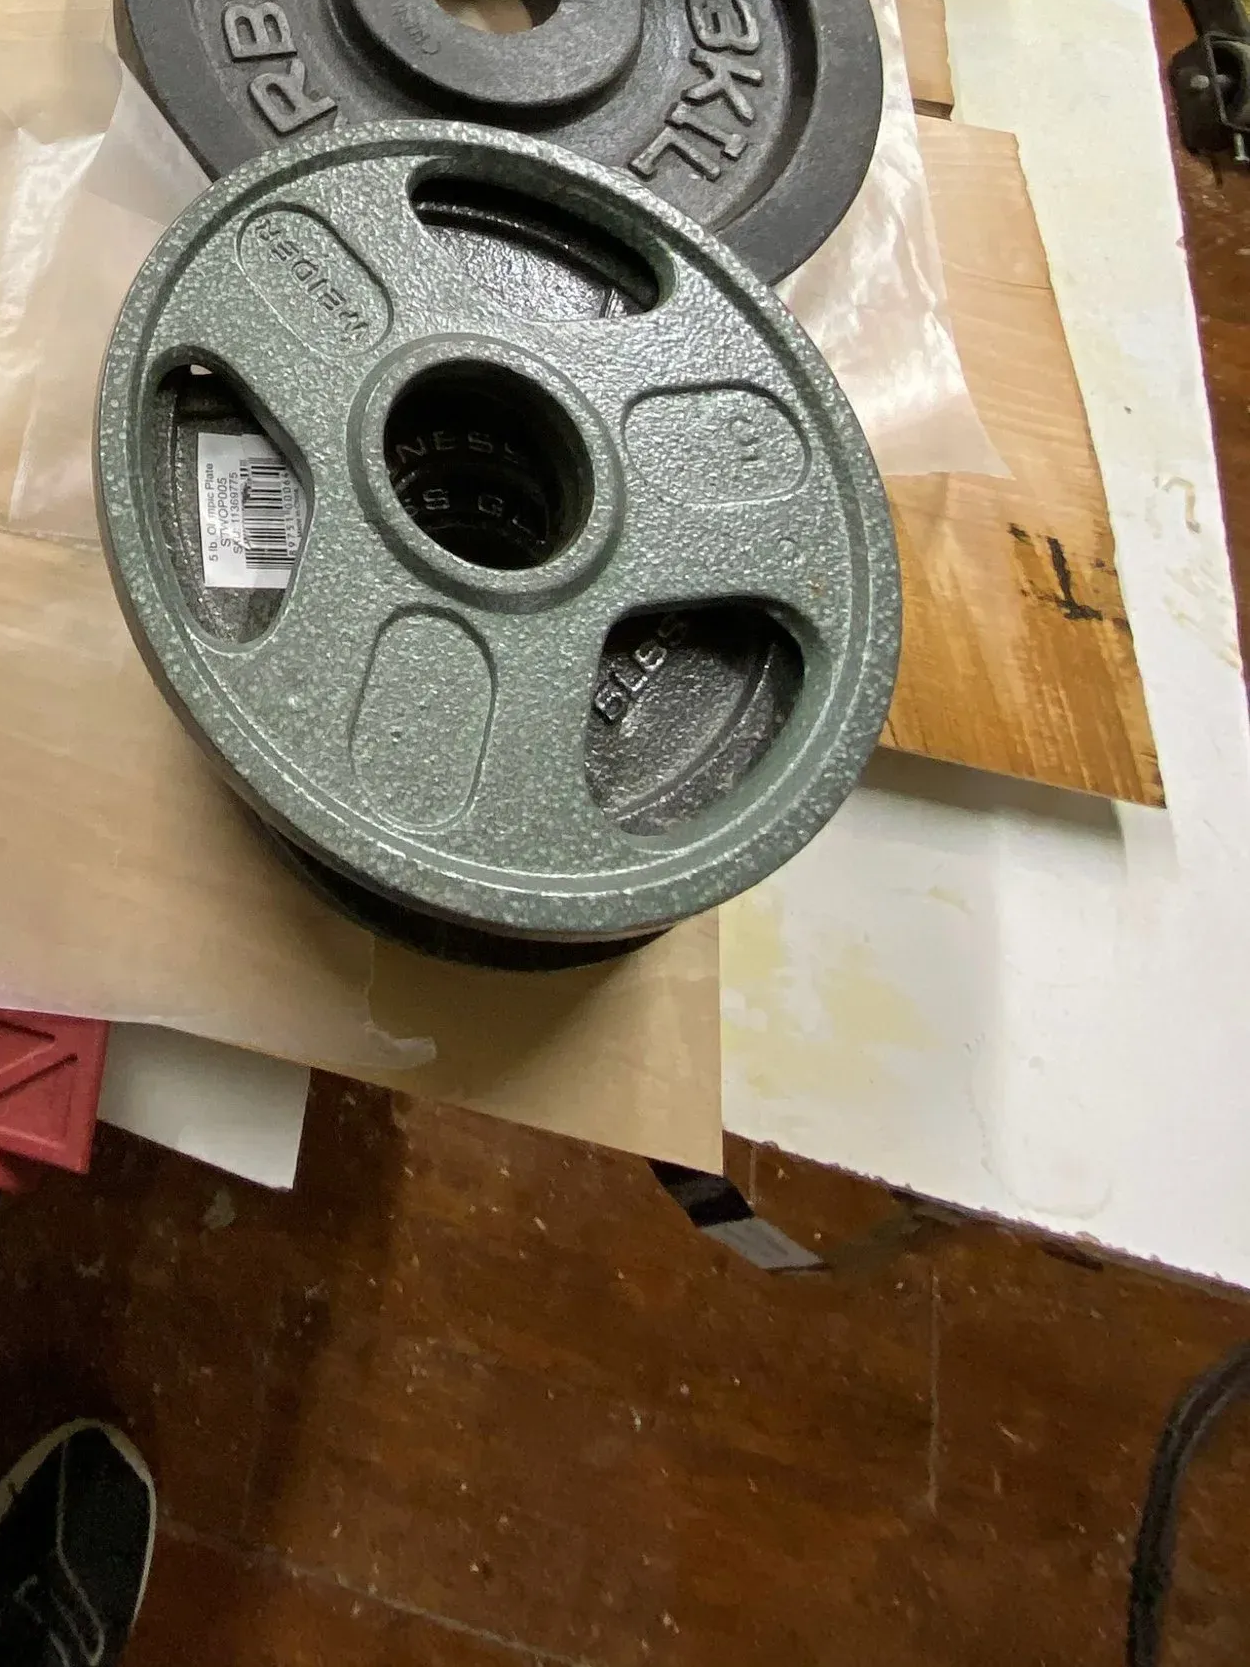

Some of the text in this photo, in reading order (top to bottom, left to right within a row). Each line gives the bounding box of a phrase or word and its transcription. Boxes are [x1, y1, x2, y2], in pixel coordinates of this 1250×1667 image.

[253, 217, 370, 345] WEIDER
[205, 463, 214, 490] Plate
[229, 471, 240, 523] 11369775
[207, 493, 217, 535] Olmpic
[208, 554, 218, 562] 5
